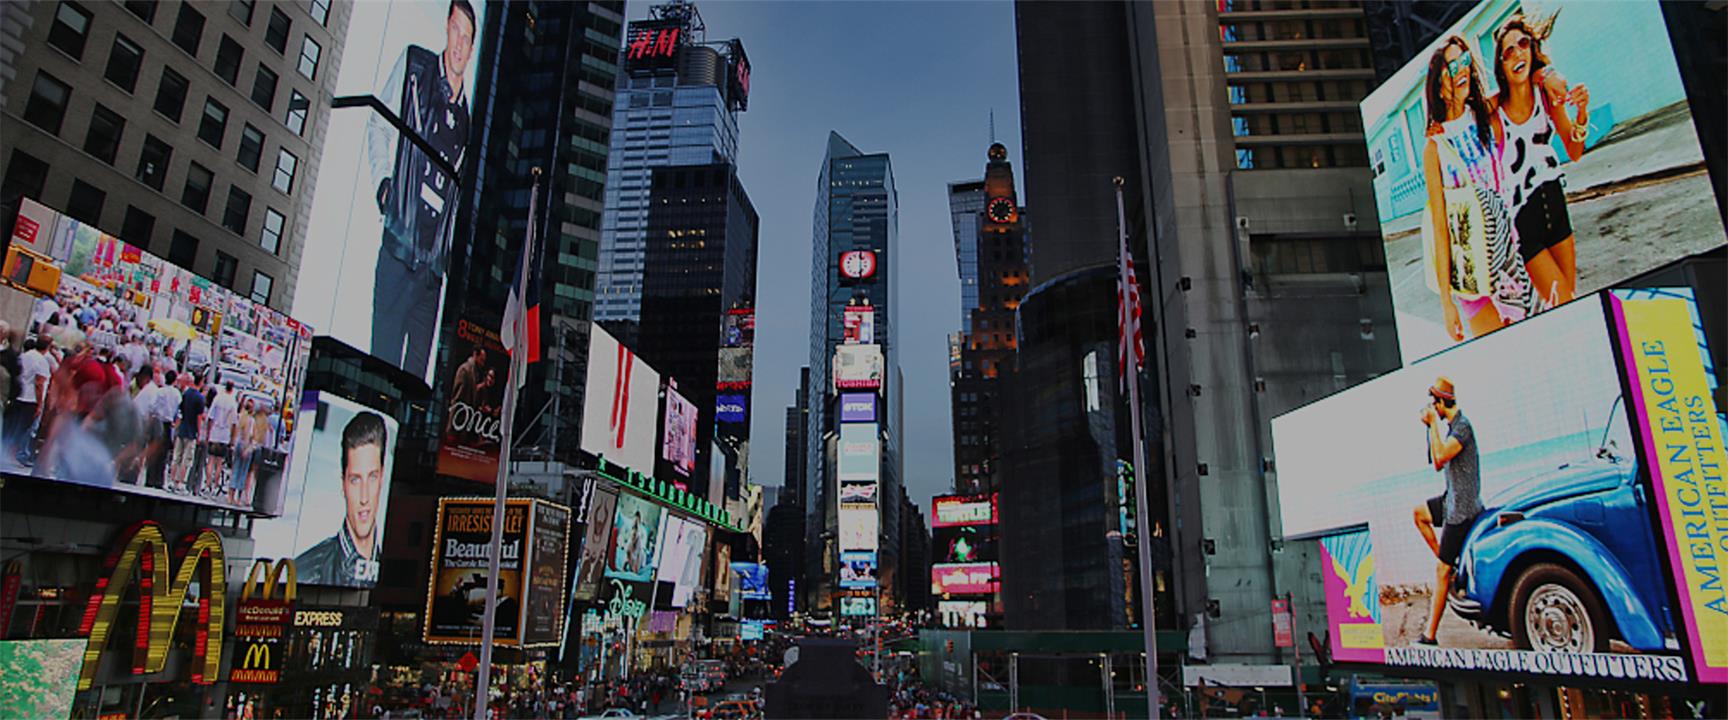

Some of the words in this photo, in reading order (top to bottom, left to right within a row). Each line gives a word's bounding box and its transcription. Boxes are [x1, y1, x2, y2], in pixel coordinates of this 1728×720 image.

[627, 27, 680, 60] H&M
[1642, 339, 1684, 433] EAGLE
[667, 483, 733, 530] BROADWAY
[446, 513, 523, 534] IRRESISTLE!
[1666, 443, 1728, 616] AMERICAN
[444, 538, 520, 559] Beautul
[293, 611, 344, 627] EXPRESS
[1384, 649, 1466, 668] AMERICAN
[1473, 651, 1529, 672] EAGLE
[1535, 652, 1684, 683] OUTFITTERS
